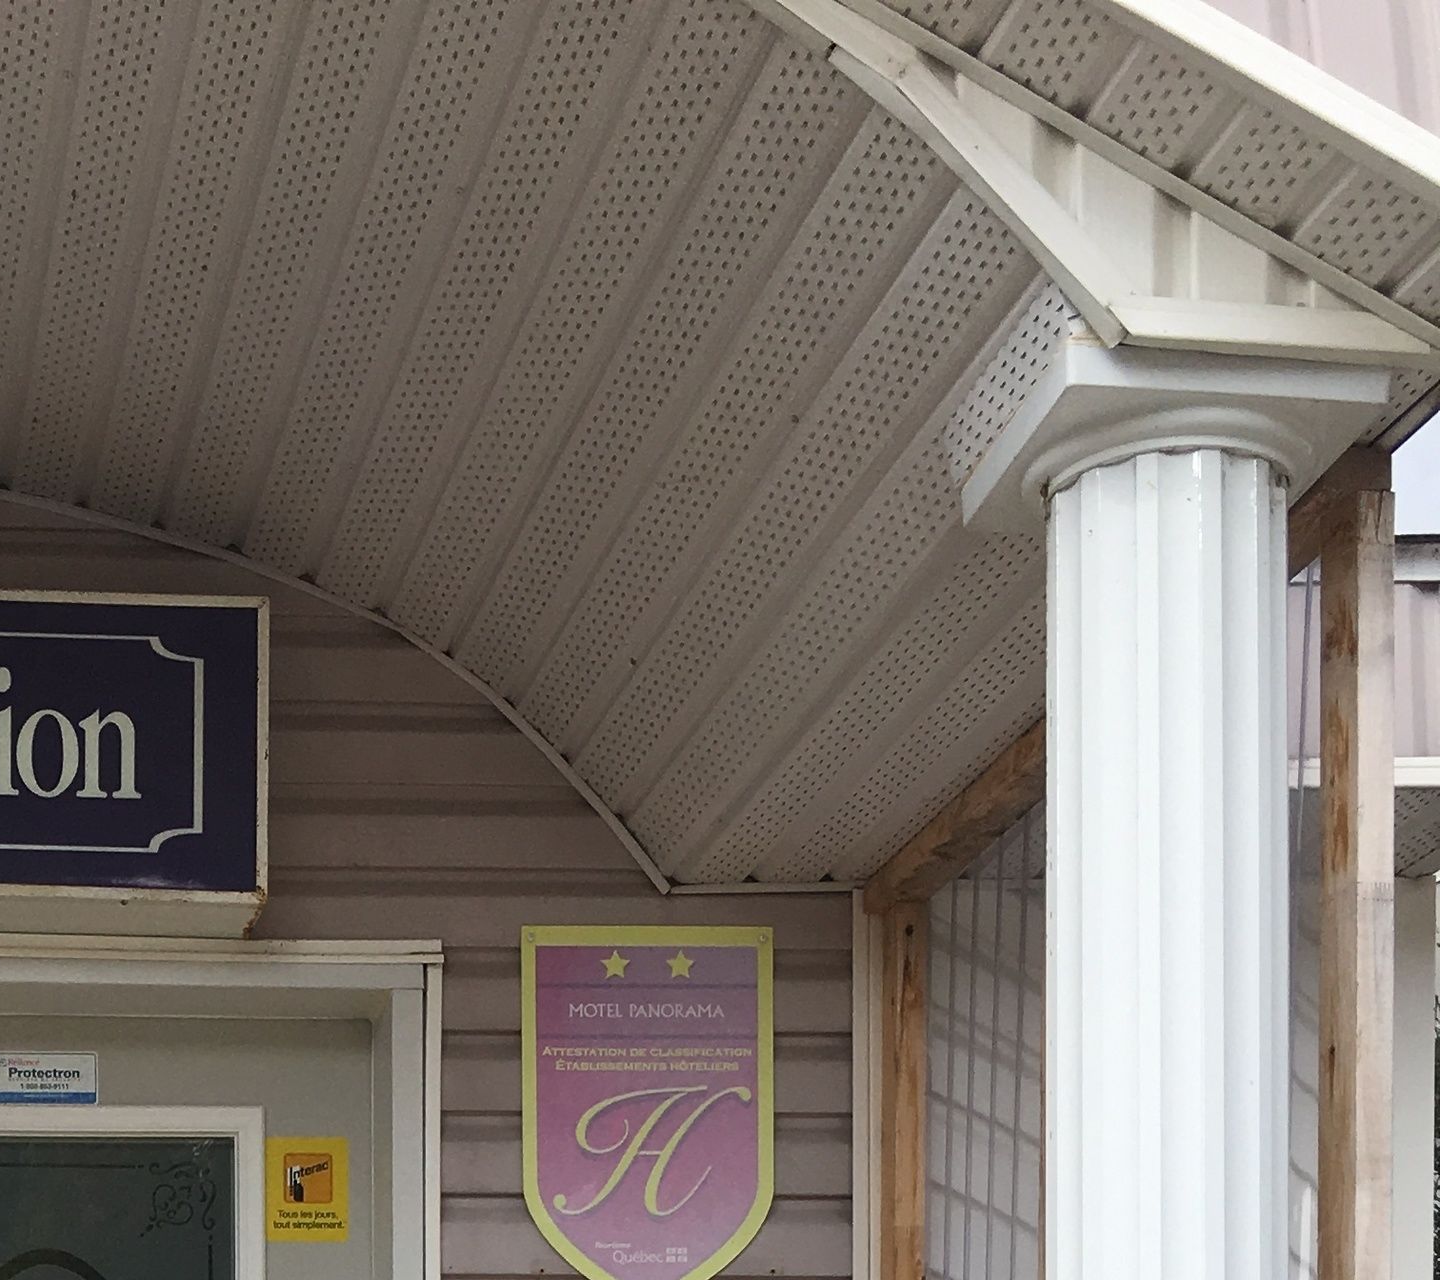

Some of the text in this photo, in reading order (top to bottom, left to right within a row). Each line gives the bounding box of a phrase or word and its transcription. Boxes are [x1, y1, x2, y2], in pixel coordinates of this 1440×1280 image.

[568, 1004, 725, 1018] MOTEL PANORAMA
[542, 1046, 752, 1057] ATTESTATION DE CLASSIFICATION
[8, 1067, 80, 1078] Protectron
[289, 1161, 329, 1185] Interac
[277, 1210, 299, 1219] Tous
[300, 1210, 313, 1219] les
[273, 1221, 291, 1229] tout
[613, 1250, 664, 1265] Québec
